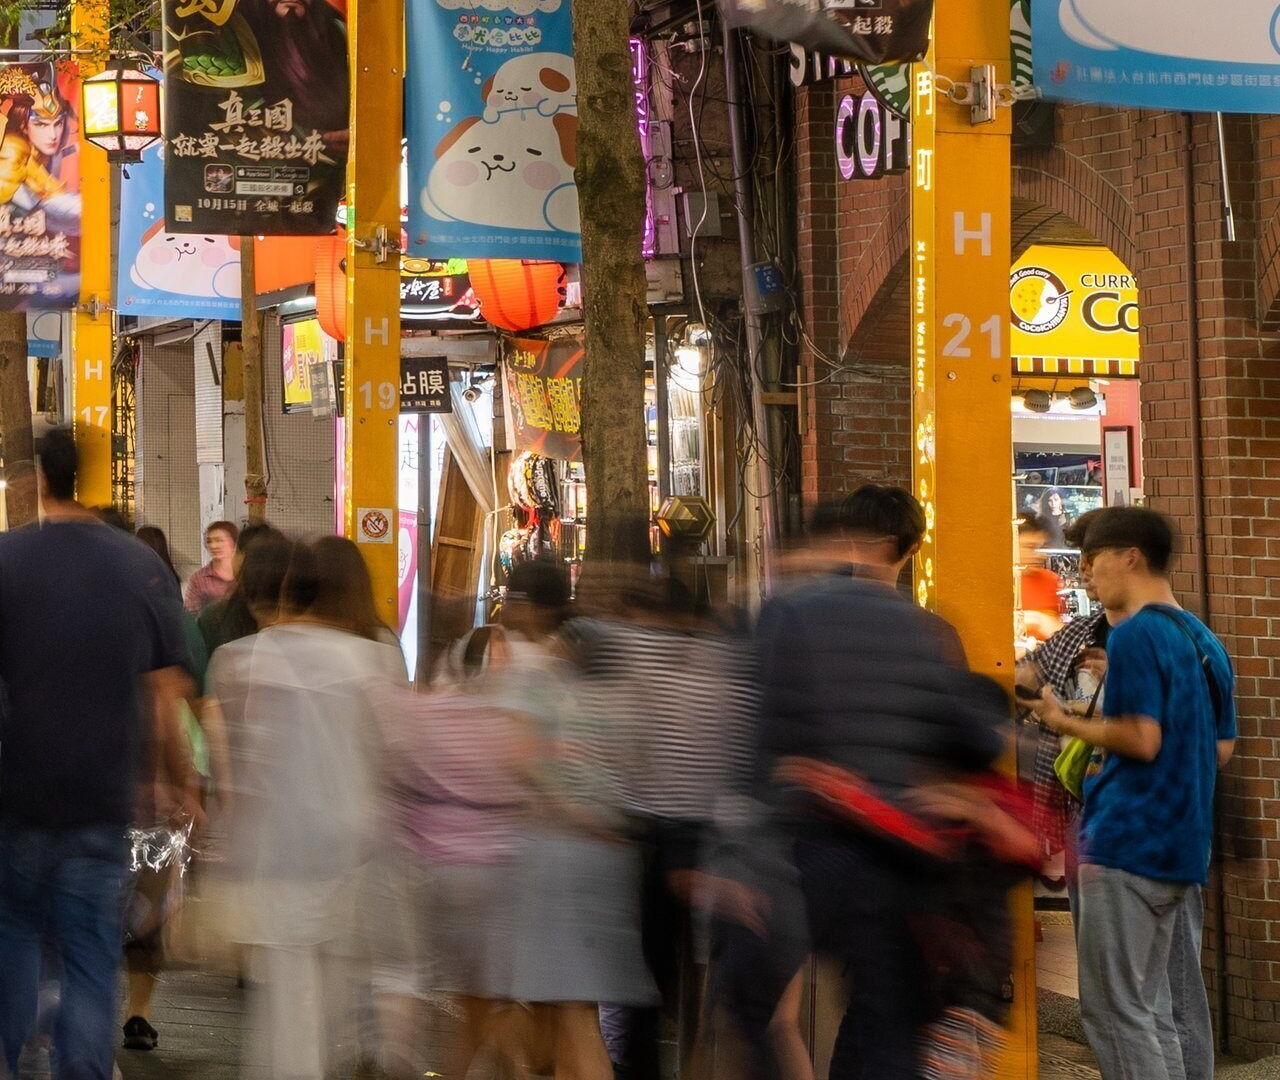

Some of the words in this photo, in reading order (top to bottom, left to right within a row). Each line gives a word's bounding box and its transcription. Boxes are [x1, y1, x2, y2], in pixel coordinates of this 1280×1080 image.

[486, 45, 508, 54] Happy
[209, 90, 293, 133] 真三國
[836, 90, 910, 180] COF
[197, 198, 247, 211] 10月15日
[953, 212, 992, 256] H
[1081, 274, 1139, 289] CURRY
[365, 317, 389, 345] H
[942, 313, 1003, 359] 21
[85, 360, 102, 381] H
[359, 382, 396, 410] 19
[81, 406, 108, 427] 17
